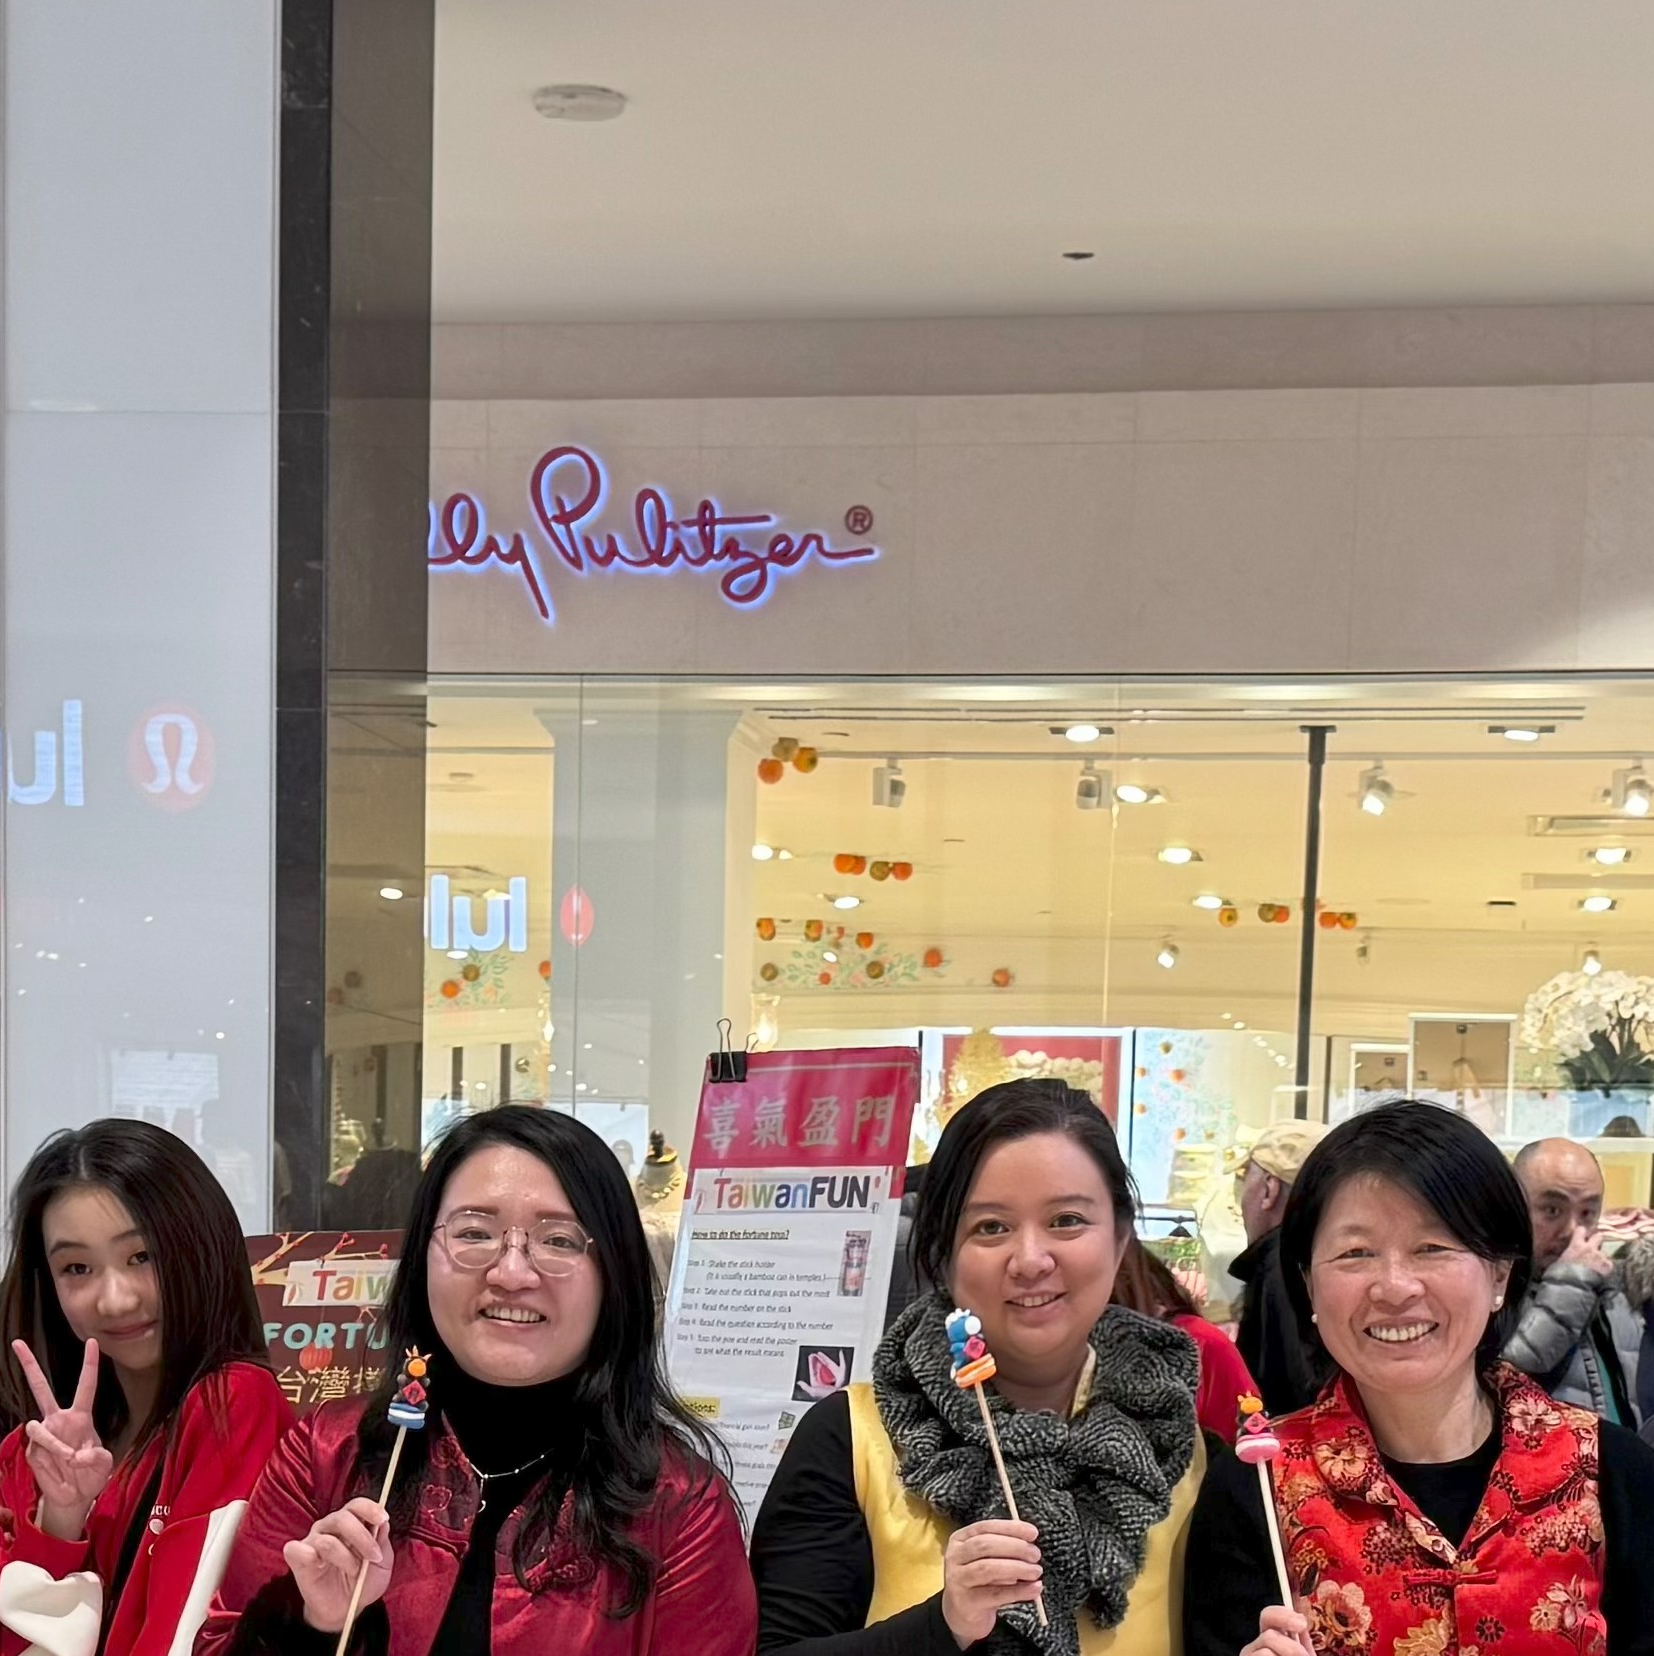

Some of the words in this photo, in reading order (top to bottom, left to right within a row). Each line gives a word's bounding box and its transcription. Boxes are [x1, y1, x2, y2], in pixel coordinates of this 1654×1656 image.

[703, 1093, 897, 1160] 喜氣盈門
[713, 1174, 871, 1210] TaiwanFUN
